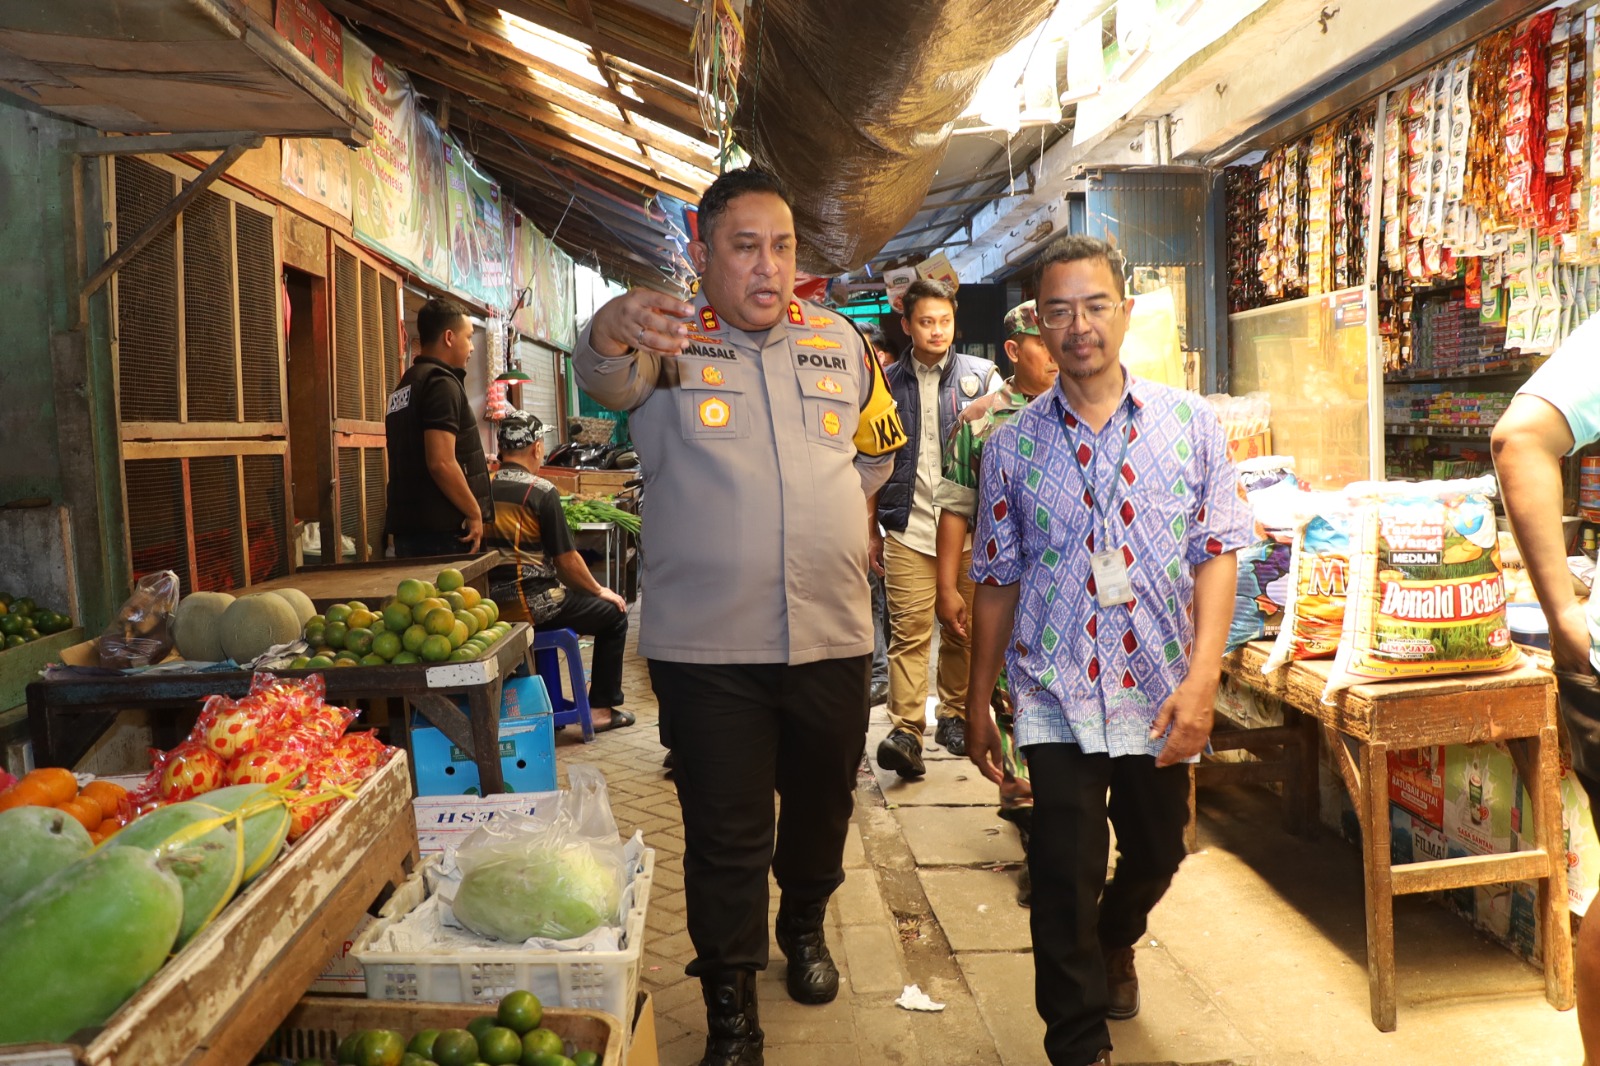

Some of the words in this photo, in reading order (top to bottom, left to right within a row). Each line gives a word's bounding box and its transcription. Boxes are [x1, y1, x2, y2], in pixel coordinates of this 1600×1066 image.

[372, 67, 388, 89] ABC
[373, 117, 388, 140] ABC
[797, 354, 847, 371] POLRI
[875, 406, 905, 450] KA
[1380, 516, 1443, 536] Pandan
[1385, 535, 1443, 551] Wangi
[1392, 552, 1438, 564] MEDIUM
[1380, 581, 1455, 619] Donald
[1409, 645, 1436, 653] JAYA
[1391, 775, 1420, 798] RATUSAN
[436, 806, 536, 824] FESH
[1415, 832, 1442, 859] FILMA
